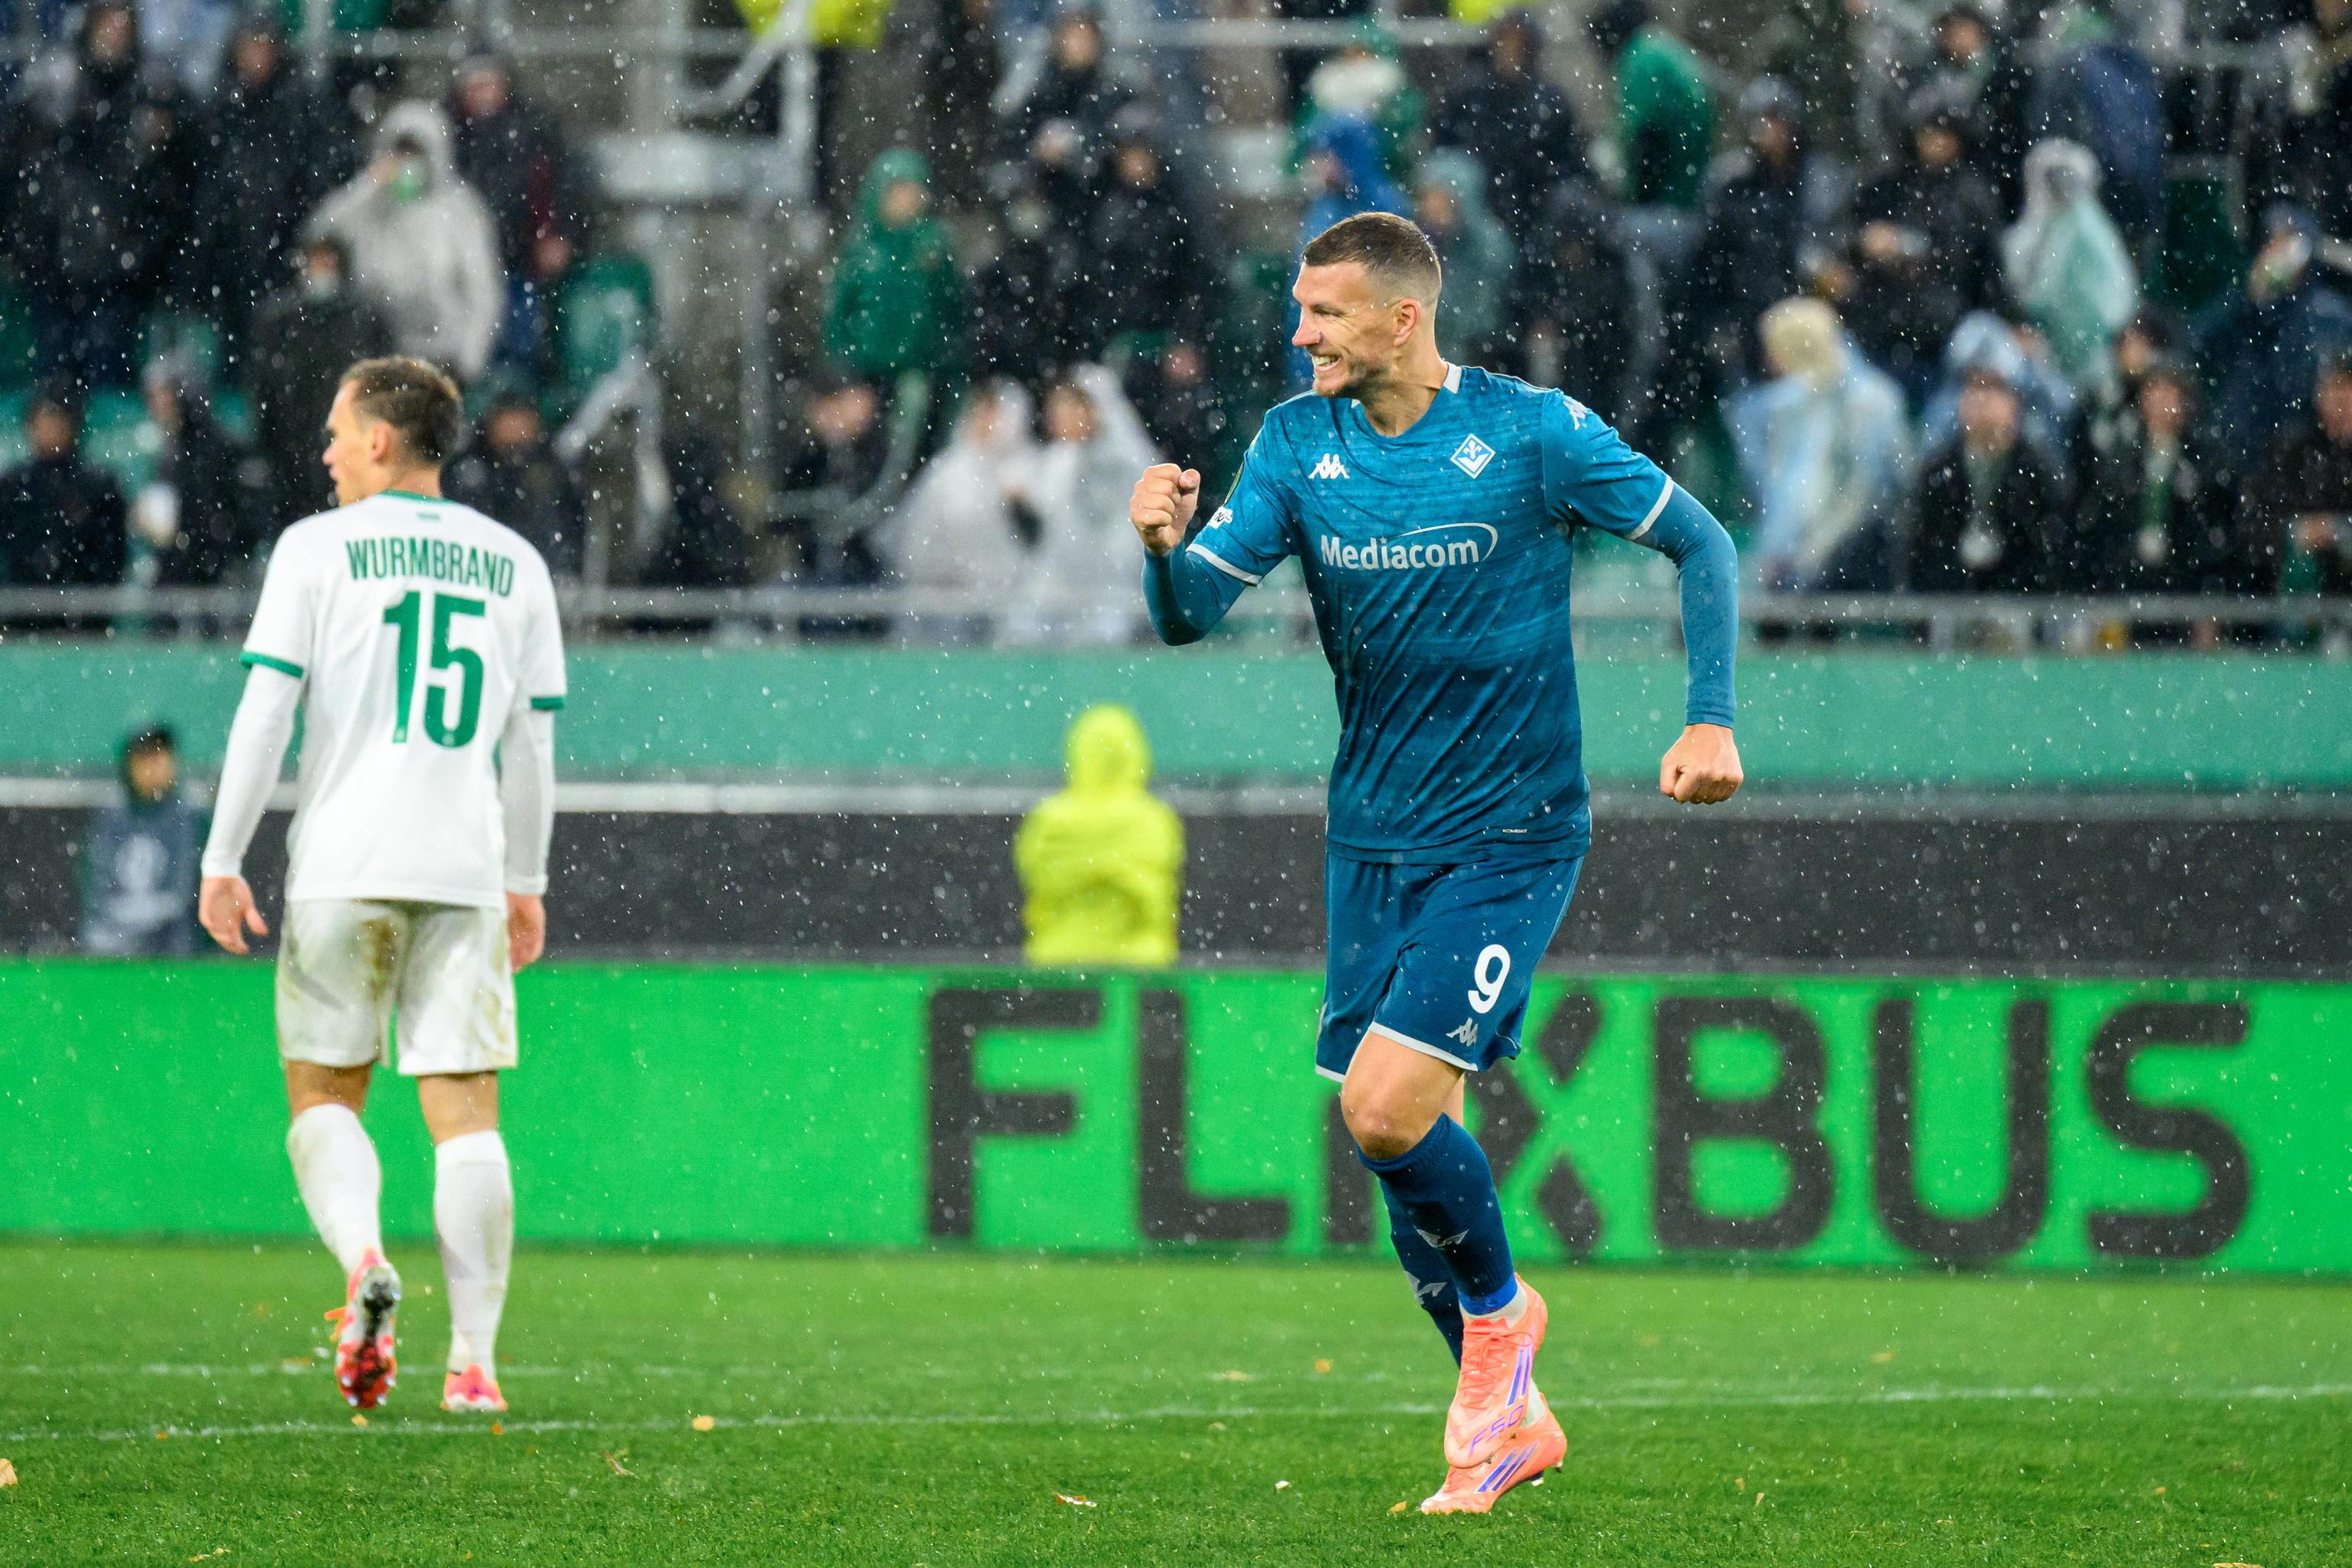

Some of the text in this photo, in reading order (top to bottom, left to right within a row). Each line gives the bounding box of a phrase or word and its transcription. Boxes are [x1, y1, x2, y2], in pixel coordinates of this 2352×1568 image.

[345, 537, 514, 597] WURMBRAND
[1321, 534, 1480, 570] Mediacom
[384, 591, 485, 749] 15
[1468, 944, 1511, 1014] 9
